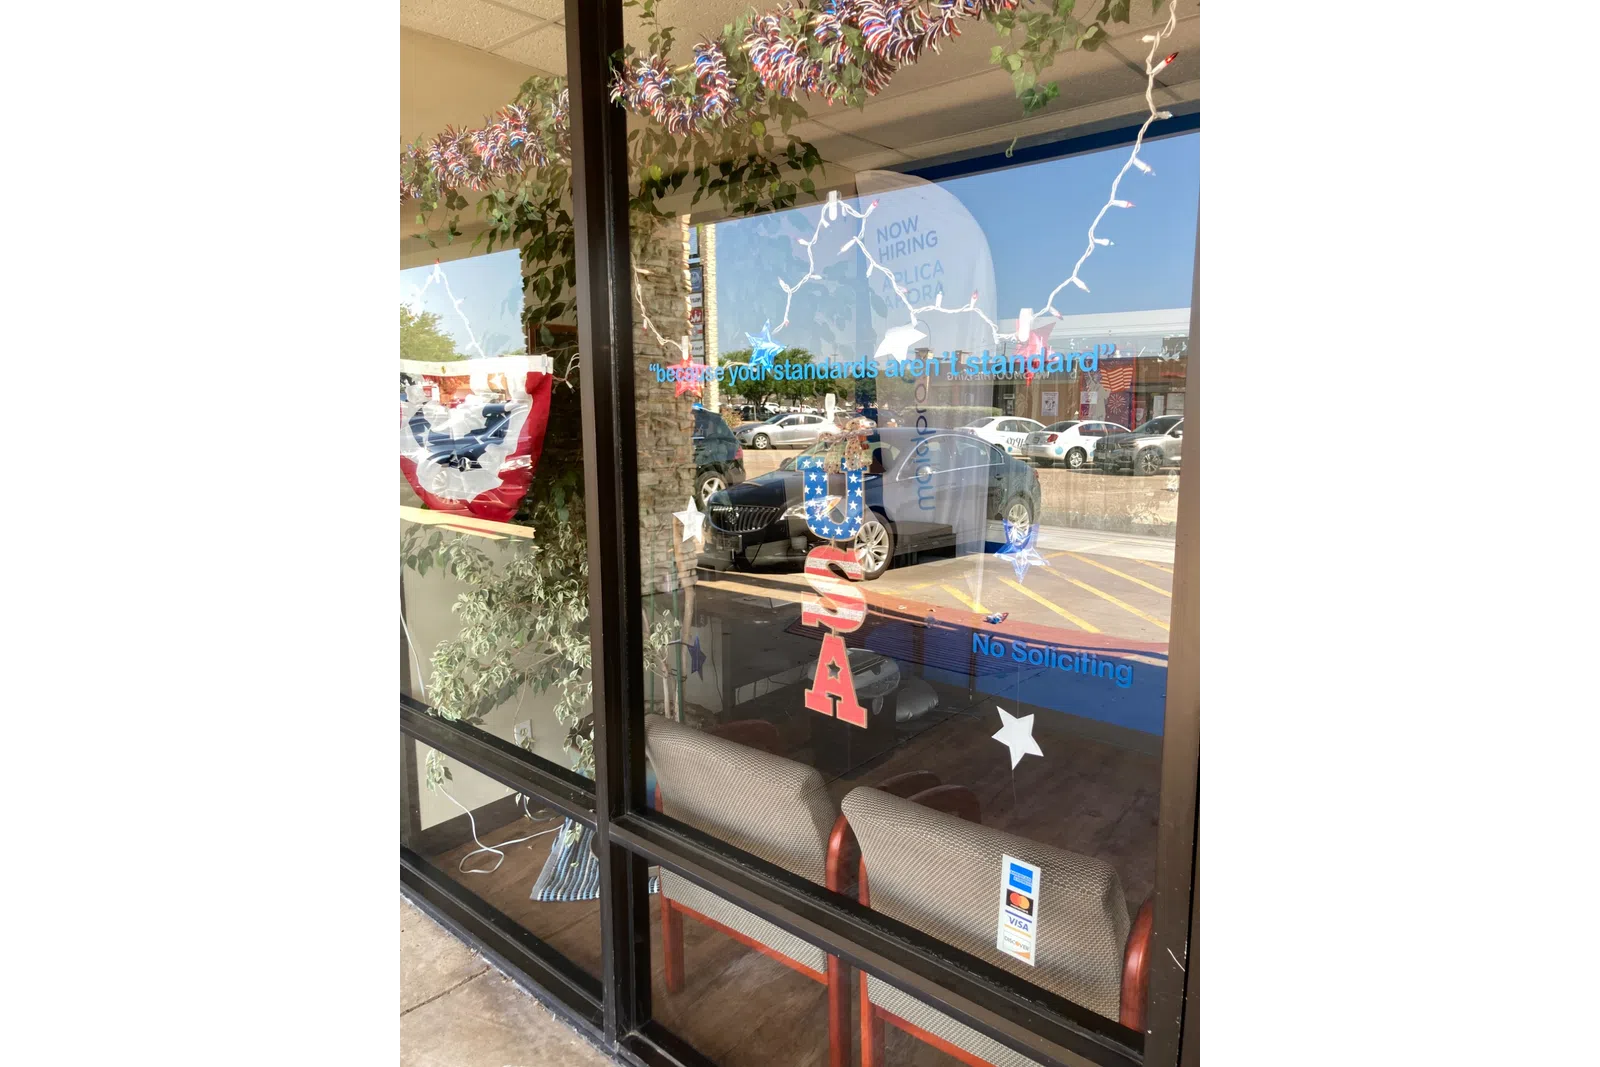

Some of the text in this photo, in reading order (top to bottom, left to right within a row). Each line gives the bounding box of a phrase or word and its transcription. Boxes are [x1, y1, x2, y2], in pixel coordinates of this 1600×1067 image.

[877, 215, 918, 244] NOW
[879, 230, 938, 263] HIRING
[882, 259, 945, 292] APLICA
[728, 363, 772, 387] your
[773, 355, 879, 381] standards
[796, 455, 868, 729] USA
[972, 632, 1134, 689] No Soliciting
[1007, 914, 1029, 932] VISA
